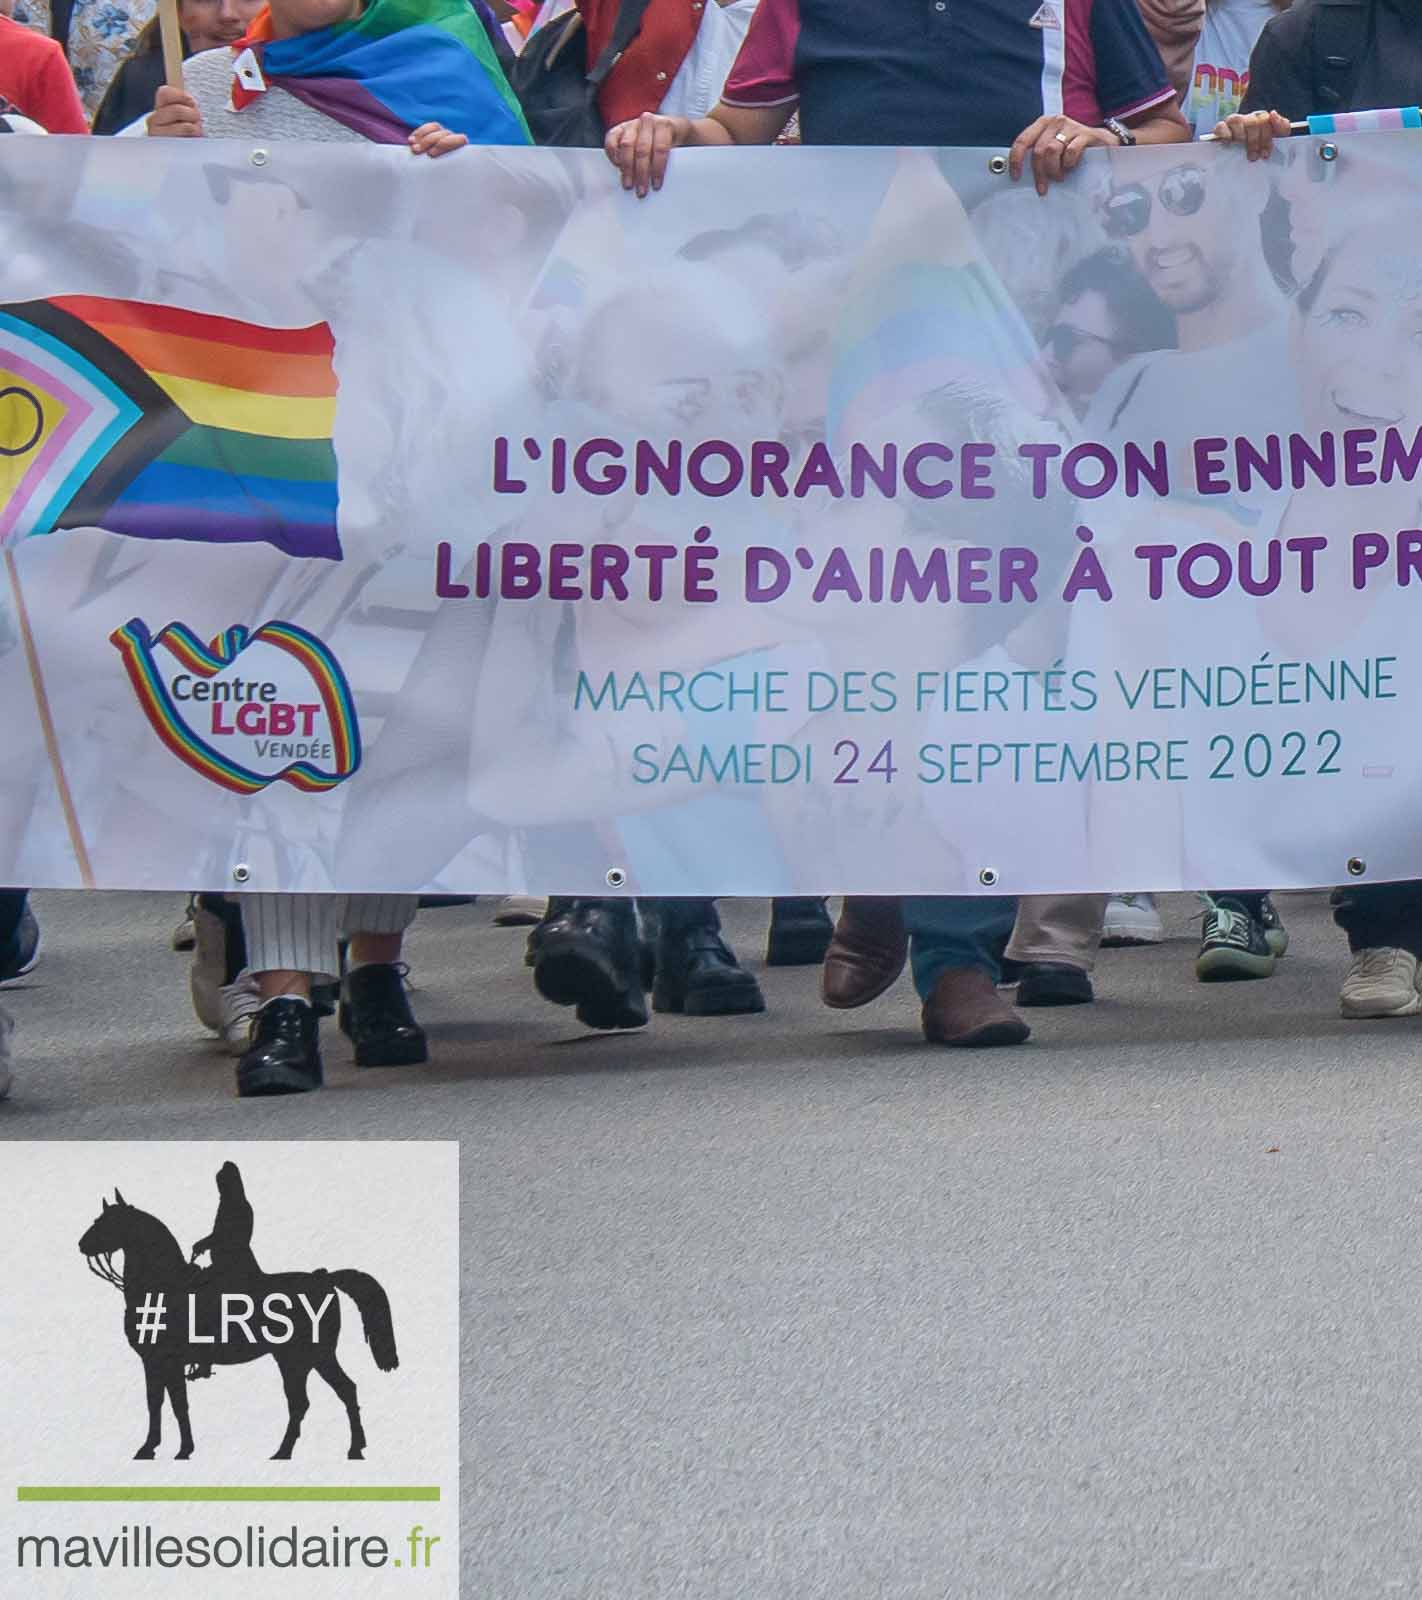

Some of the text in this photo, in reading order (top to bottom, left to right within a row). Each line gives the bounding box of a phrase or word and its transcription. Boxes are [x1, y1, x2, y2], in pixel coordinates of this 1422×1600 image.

[492, 436, 997, 500] L'IGNORANCE
[1026, 440, 1171, 500] TON
[435, 525, 719, 605] LIBERTÉ
[745, 544, 1038, 605] D'AIMER
[1064, 525, 1115, 603] À
[1134, 534, 1328, 599] TOUT
[171, 675, 277, 703] Centre
[574, 652, 1398, 715] MARCHE DES FIERTÉS VENDÉENNE
[211, 702, 321, 737] LGBT
[254, 736, 332, 760] VENDÉE
[630, 729, 1343, 786] SAMEDI 24 SEPTEMBRE 2022
